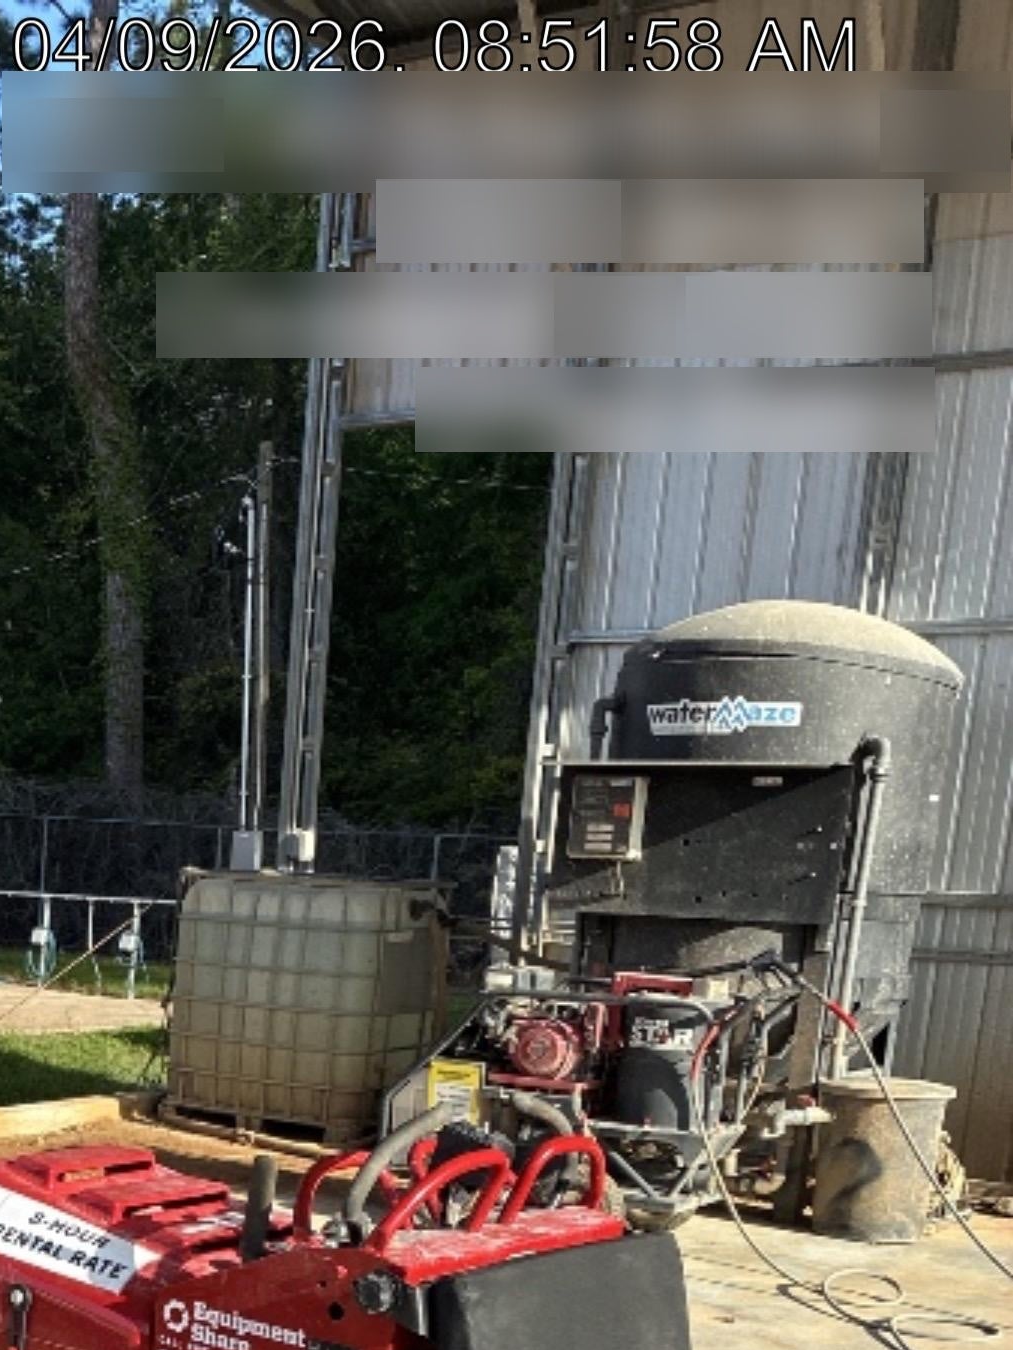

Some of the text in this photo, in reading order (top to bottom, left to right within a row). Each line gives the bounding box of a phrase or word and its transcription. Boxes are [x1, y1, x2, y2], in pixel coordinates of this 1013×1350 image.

[27, 1211, 112, 1249] 8-HOUR
[67, 1249, 129, 1280] RATE
[192, 1300, 307, 1349] Equipment
